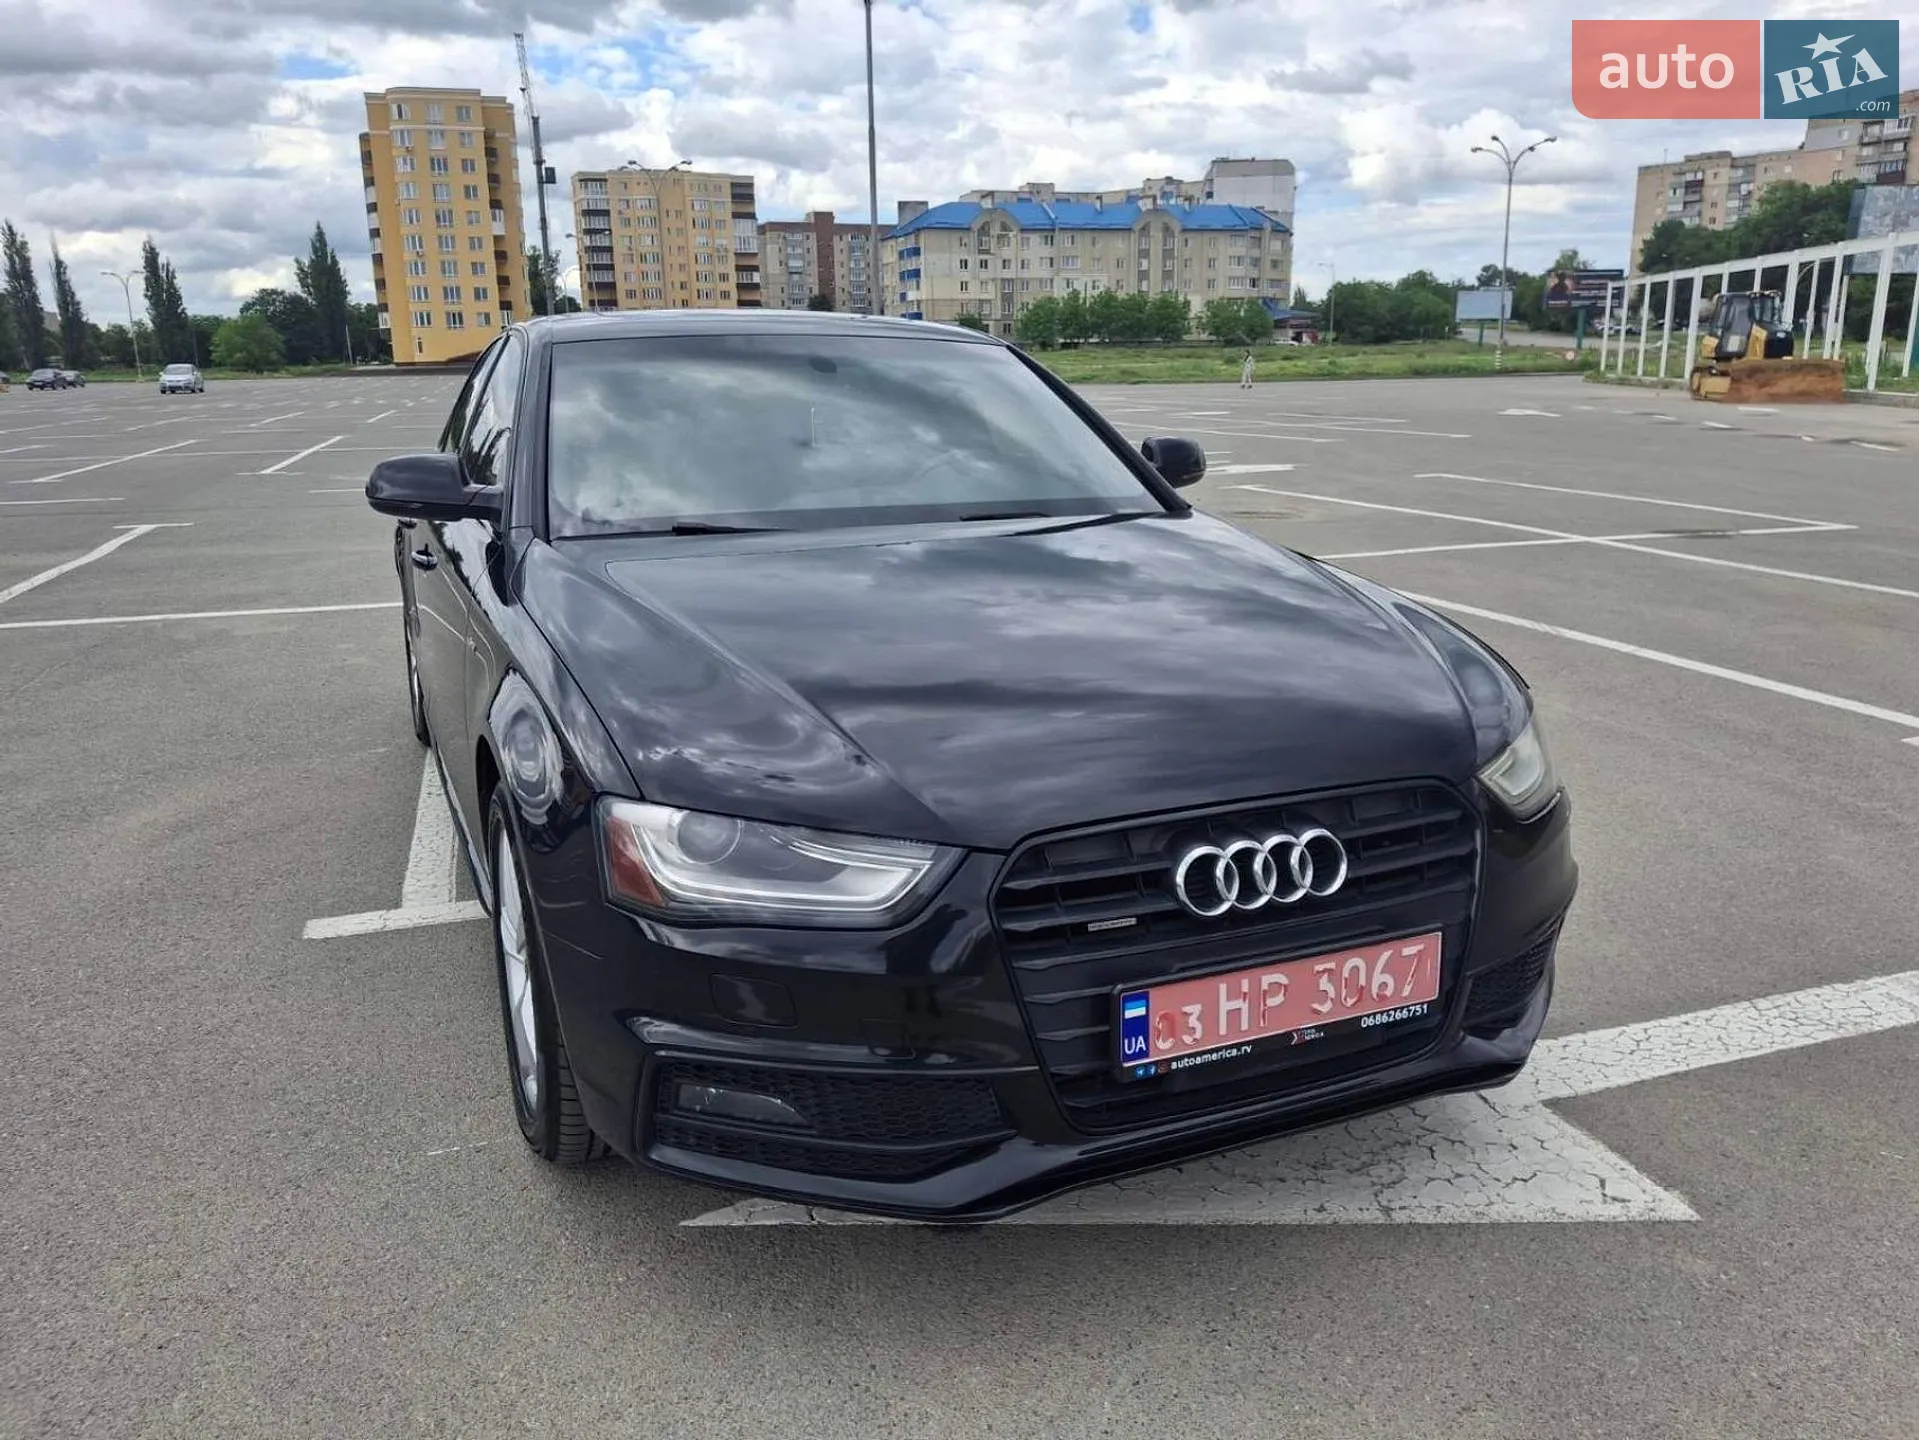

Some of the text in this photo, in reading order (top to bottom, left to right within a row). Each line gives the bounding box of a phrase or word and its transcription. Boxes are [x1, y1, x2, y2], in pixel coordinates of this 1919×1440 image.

[1154, 1004, 1203, 1051] 03
[1310, 943, 1425, 1016] 3067
[1361, 1002, 1429, 1028] 0686266751
[1124, 1034, 1147, 1055] UA
